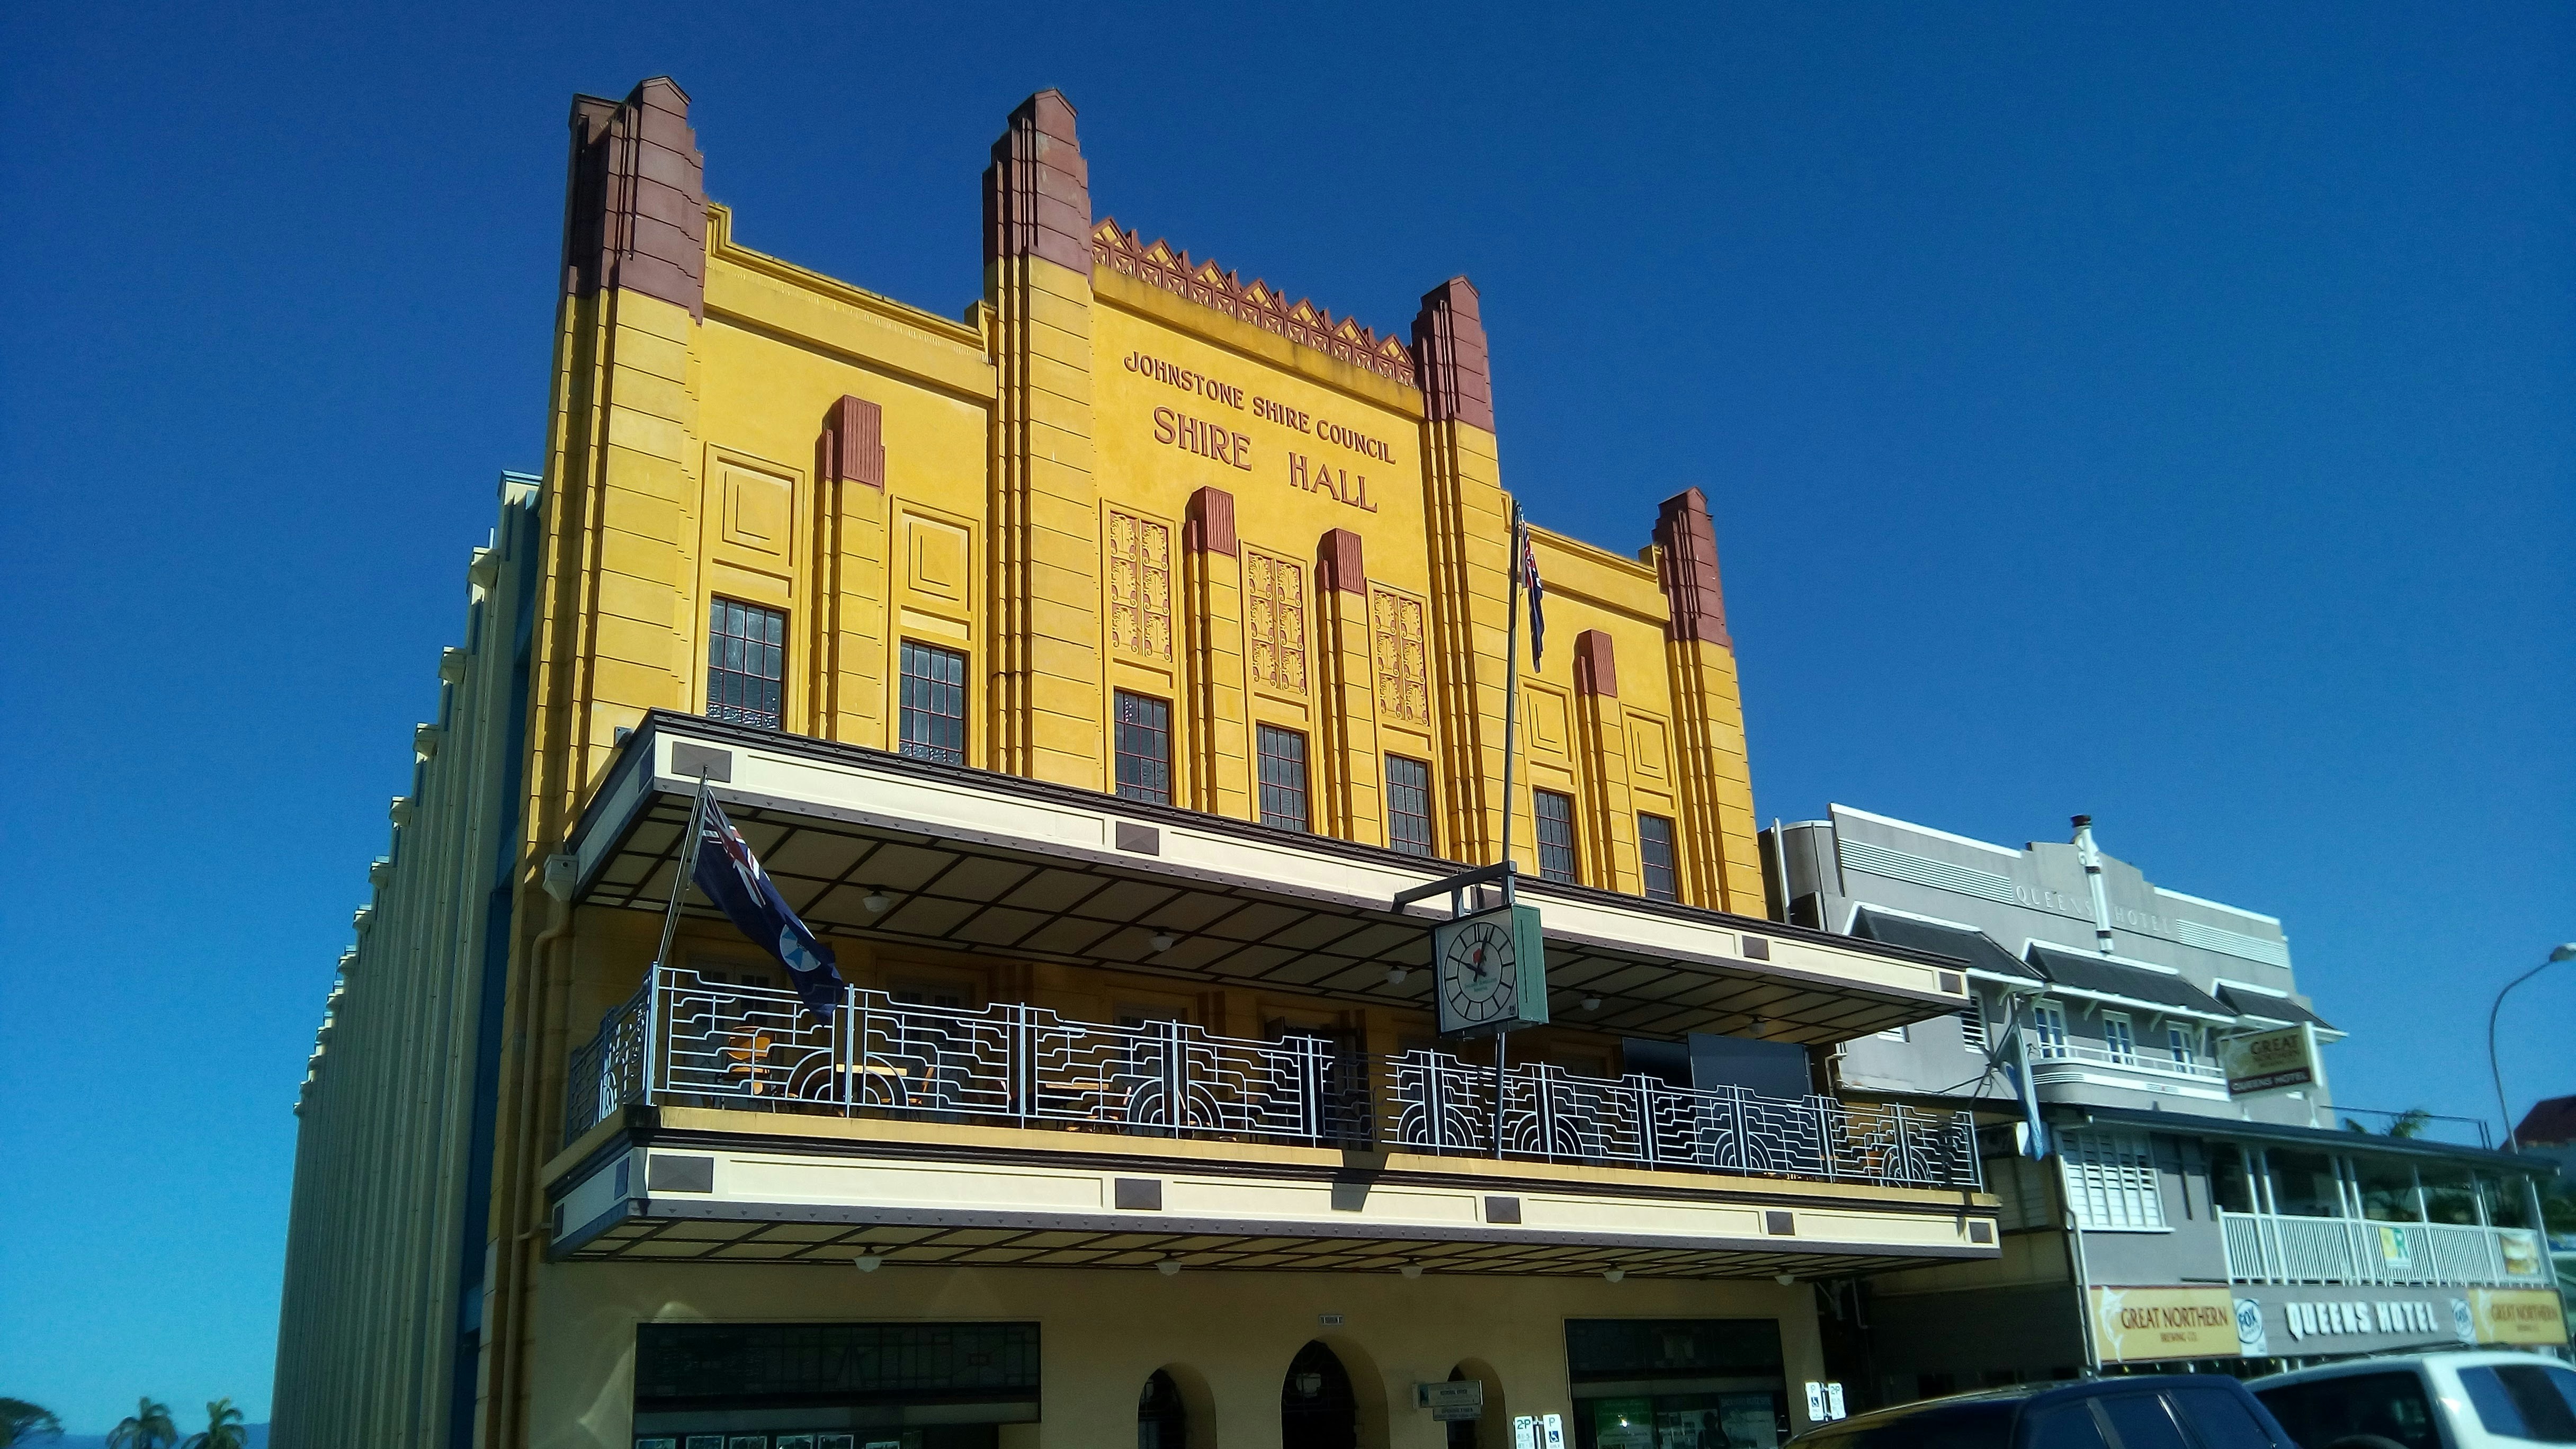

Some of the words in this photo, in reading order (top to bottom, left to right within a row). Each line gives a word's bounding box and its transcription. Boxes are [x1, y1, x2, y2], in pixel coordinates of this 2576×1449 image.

[1124, 351, 1245, 410] JOHNSTONE
[1253, 396, 1311, 434] SHIRE
[1316, 419, 1397, 464] COUNCIL
[1153, 406, 1253, 471] SHIRE
[1289, 451, 1378, 513] HALL
[2016, 885, 2092, 917] QUEENS
[2114, 905, 2171, 934] HOTEL
[2250, 1034, 2298, 1055] GREAT
[2121, 1307, 2160, 1329] GREAT
[2162, 1307, 2229, 1328] NORTHERN
[2285, 1301, 2372, 1342] QUEENS
[2375, 1300, 2438, 1333] HOTEL
[1517, 1419, 1531, 1430] 2P
[1549, 1417, 1555, 1427] P
